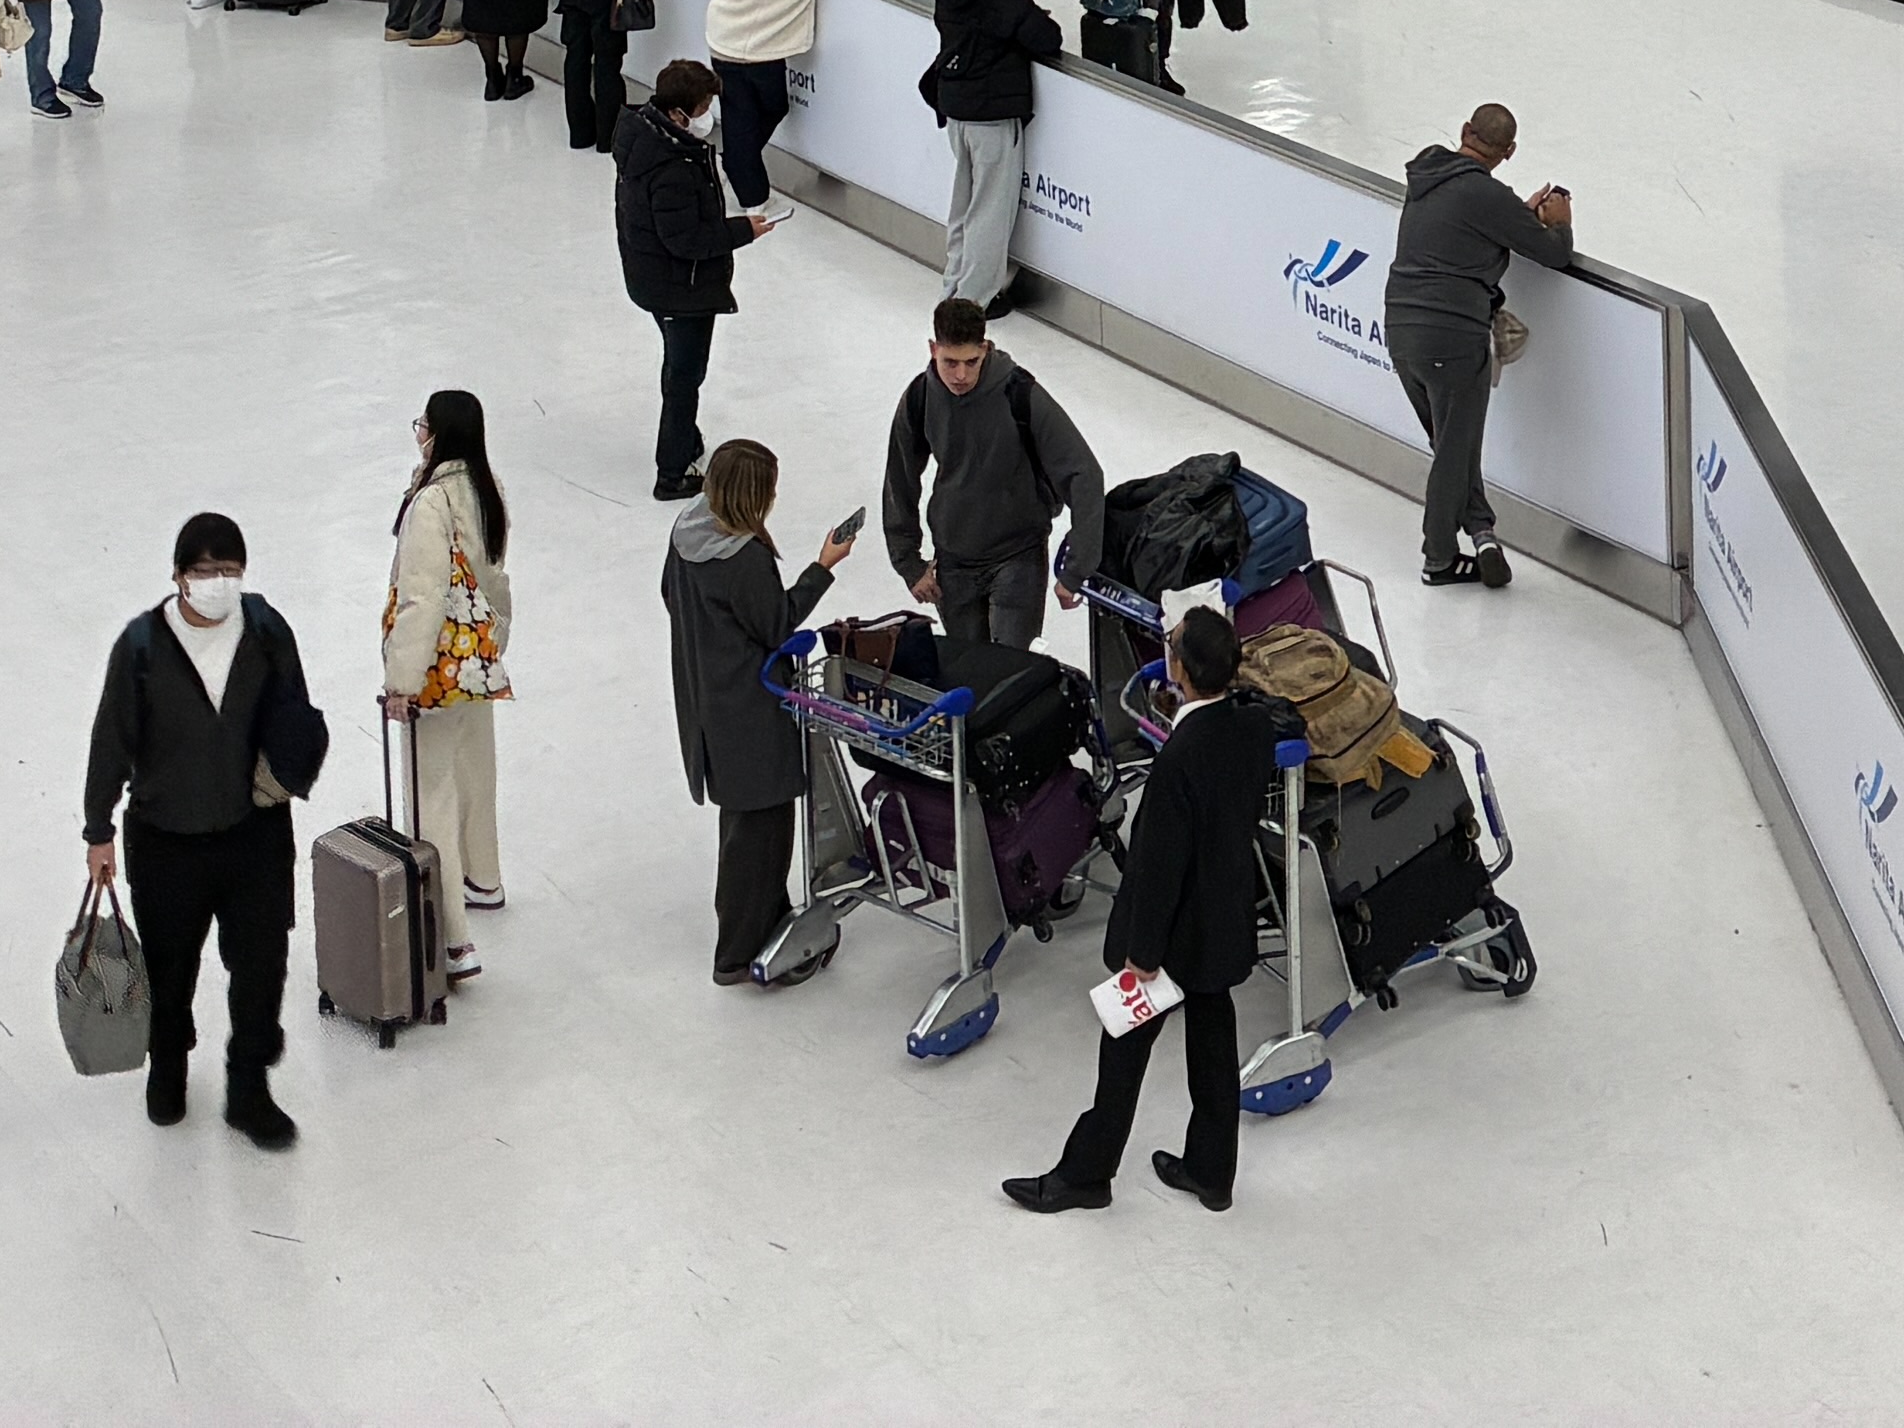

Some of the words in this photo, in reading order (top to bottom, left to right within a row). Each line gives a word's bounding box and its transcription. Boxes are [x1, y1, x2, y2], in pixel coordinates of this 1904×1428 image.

[789, 68, 816, 94] port
[1037, 172, 1091, 216] Airport
[1305, 290, 1362, 337] Narita
